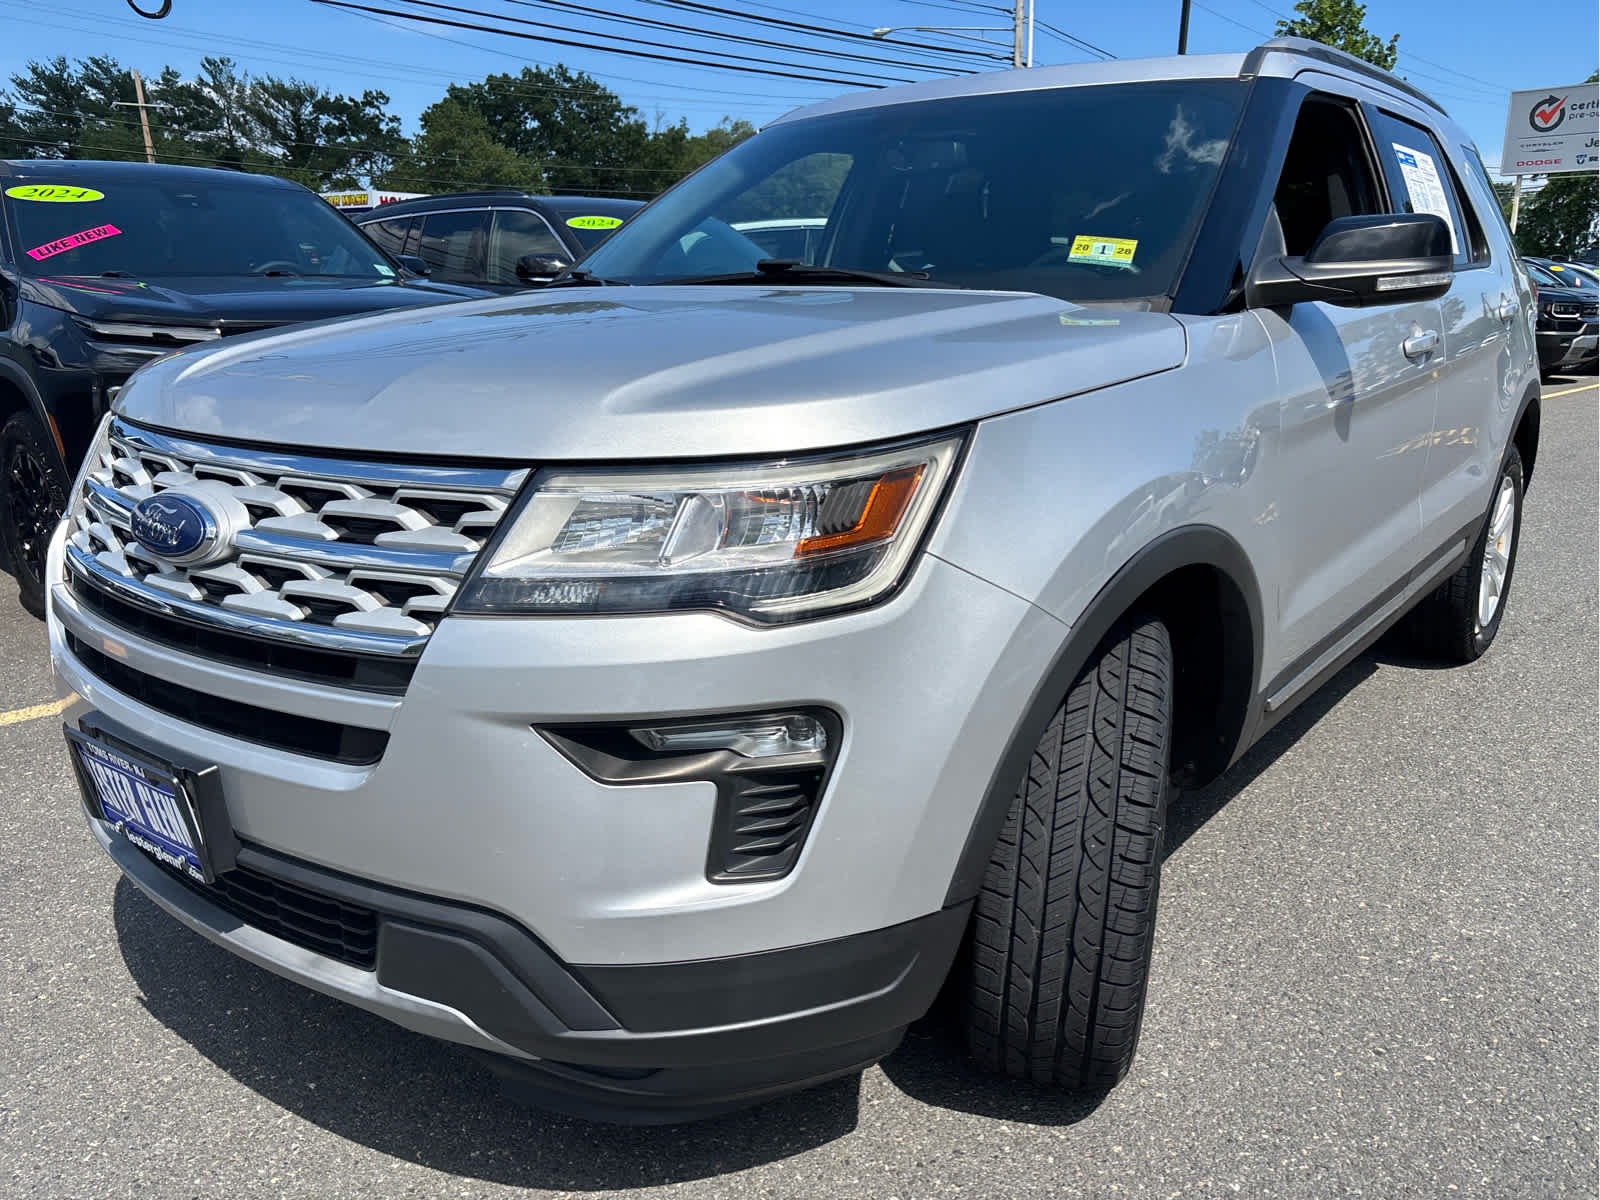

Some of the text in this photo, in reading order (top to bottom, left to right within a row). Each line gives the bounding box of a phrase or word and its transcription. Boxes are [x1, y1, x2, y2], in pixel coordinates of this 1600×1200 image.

[1516, 158, 1562, 167] DODGE
[23, 188, 88, 198] 2024
[342, 194, 368, 206] WASH
[577, 219, 616, 227] 2024
[36, 228, 108, 256] LIKE NEW
[1075, 244, 1090, 252] 20
[1100, 245, 1106, 255] 1
[136, 503, 187, 545] Ford
[80, 754, 194, 849] LESTER GLENN
